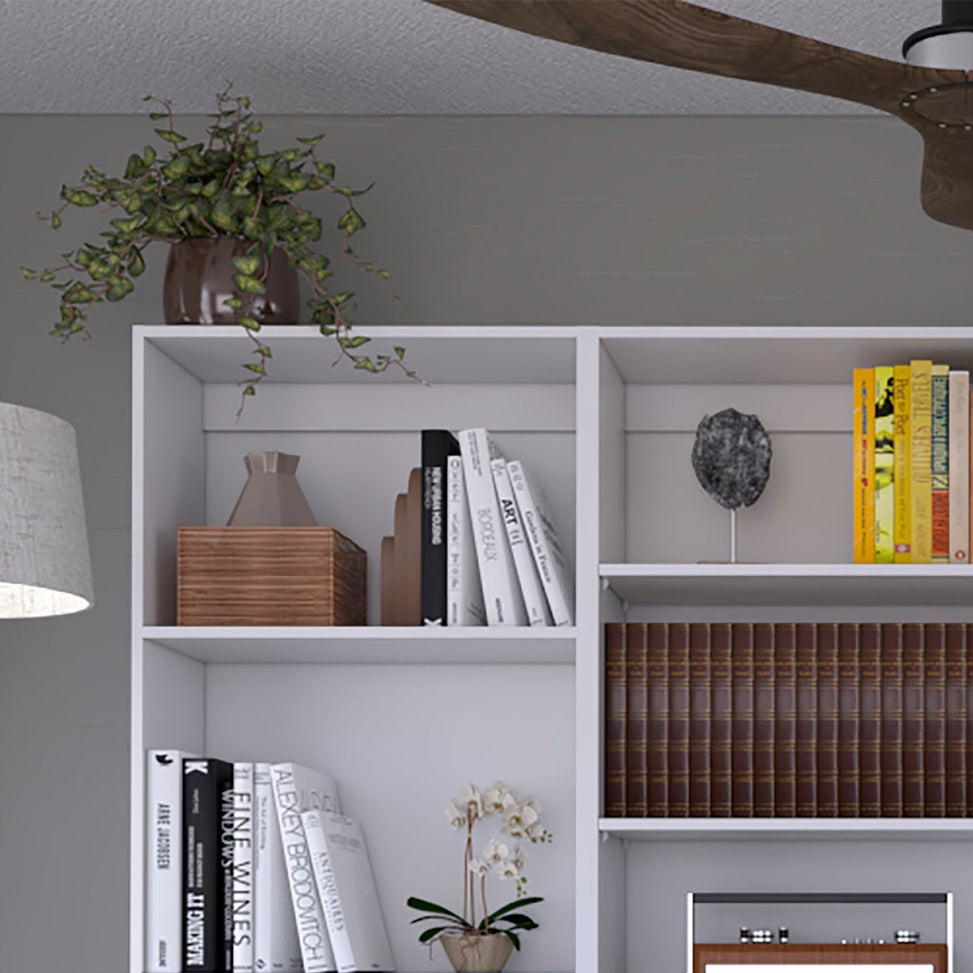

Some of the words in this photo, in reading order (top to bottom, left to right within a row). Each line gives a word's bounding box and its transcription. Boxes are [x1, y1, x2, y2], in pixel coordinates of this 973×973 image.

[896, 414, 909, 435] Poet
[501, 498, 517, 525] ART
[157, 803, 170, 825] ARNE
[221, 789, 235, 867] WINDOWS
[234, 792, 251, 848] FINE
[273, 768, 303, 838] ALEXEY
[157, 828, 170, 870] JACOBSEN
[186, 893, 204, 908] IT
[234, 861, 251, 946] WINES
[287, 844, 323, 962] BRODOVITCH
[186, 910, 204, 966] MAKING
